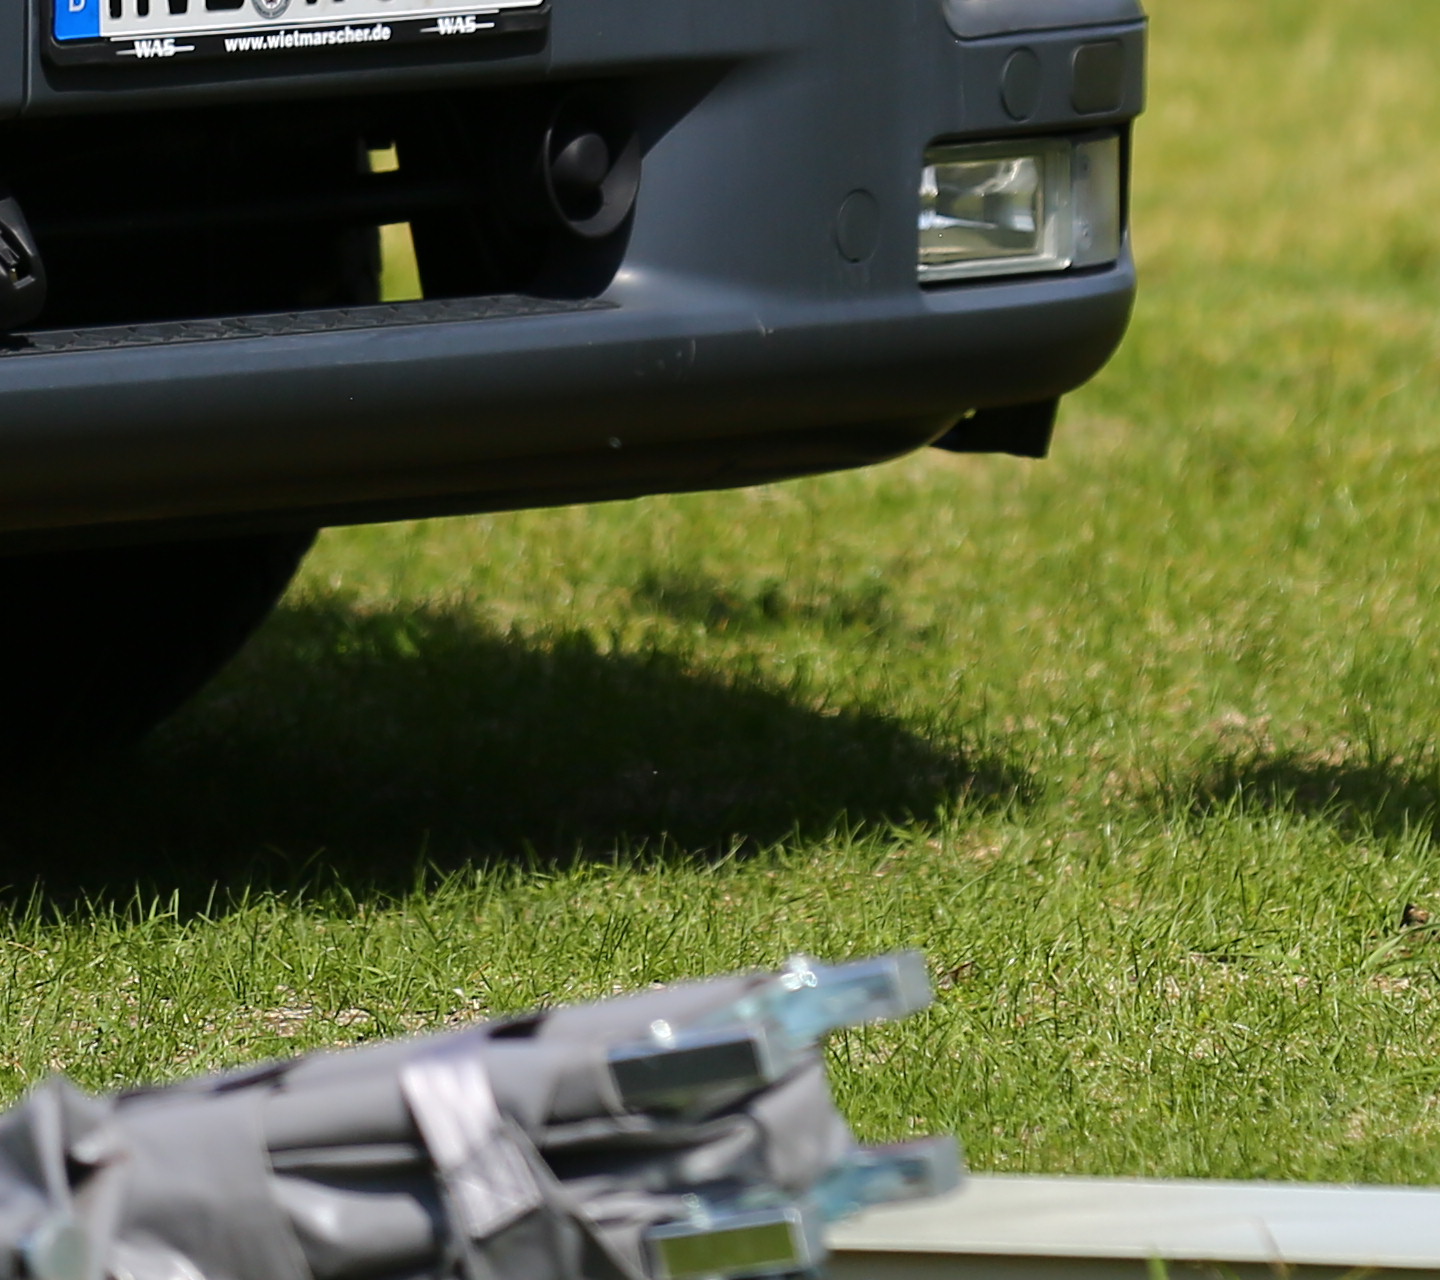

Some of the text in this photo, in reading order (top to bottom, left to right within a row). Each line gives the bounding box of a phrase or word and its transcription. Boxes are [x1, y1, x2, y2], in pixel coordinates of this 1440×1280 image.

[134, 15, 477, 59] WAS www.wietmarscher.de WAS
